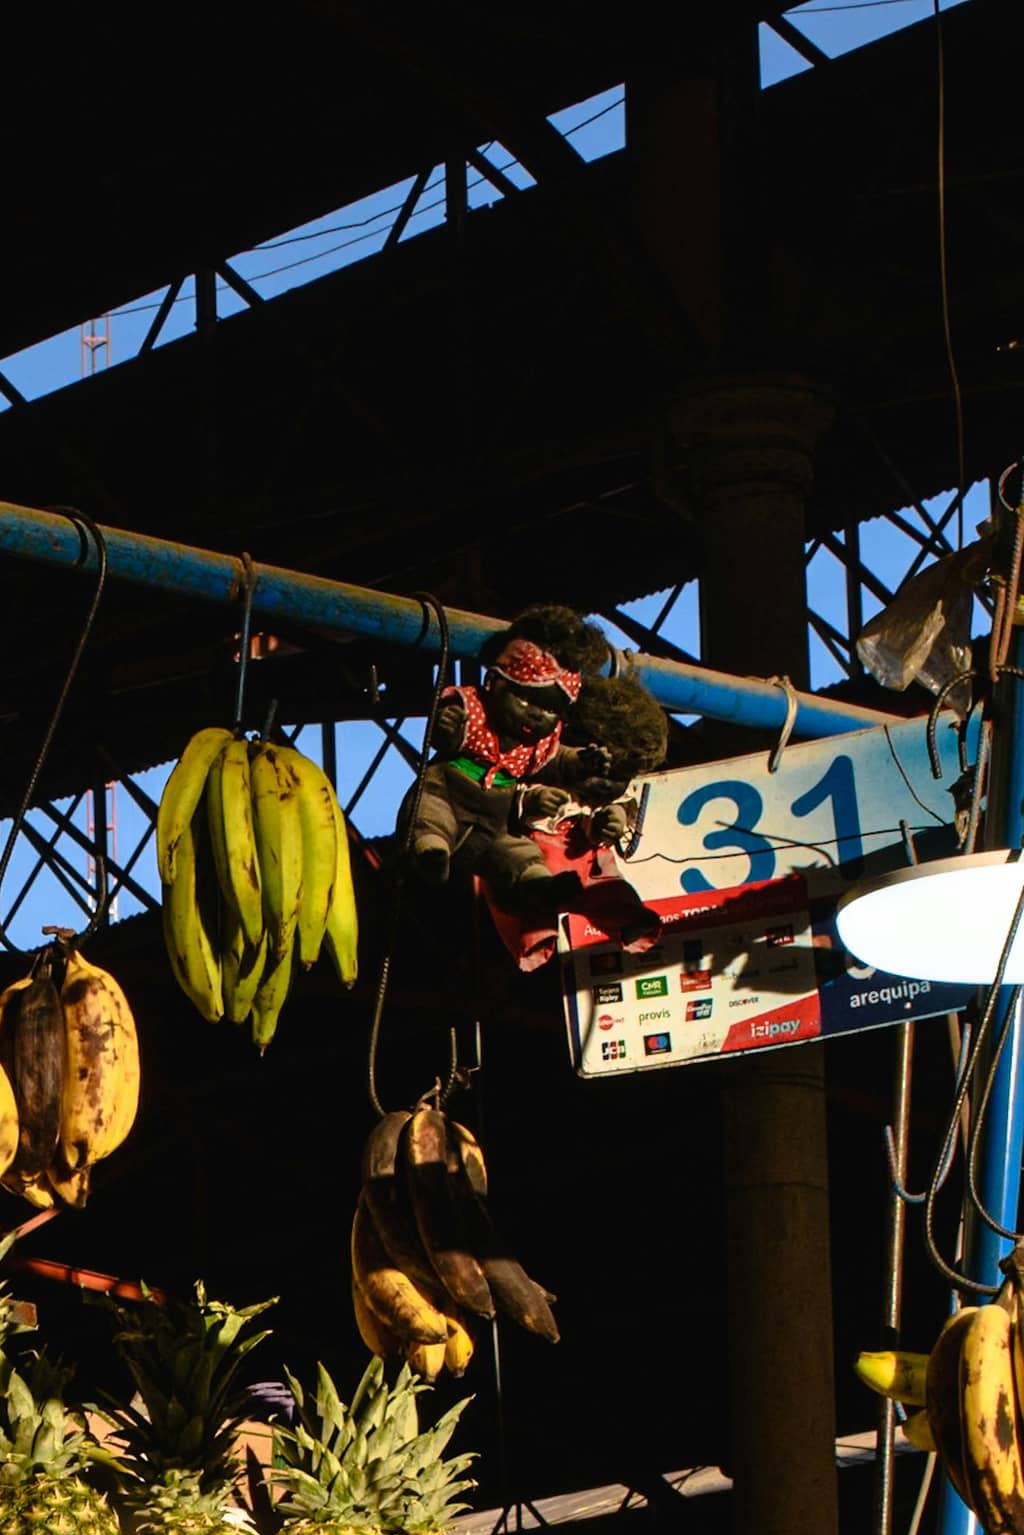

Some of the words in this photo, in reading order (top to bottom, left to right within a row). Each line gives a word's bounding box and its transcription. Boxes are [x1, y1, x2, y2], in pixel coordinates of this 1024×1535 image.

[677, 754, 864, 894] 31
[849, 980, 931, 1008] arequipa
[639, 1008, 671, 1026] provis
[750, 1019, 800, 1037] izipay
